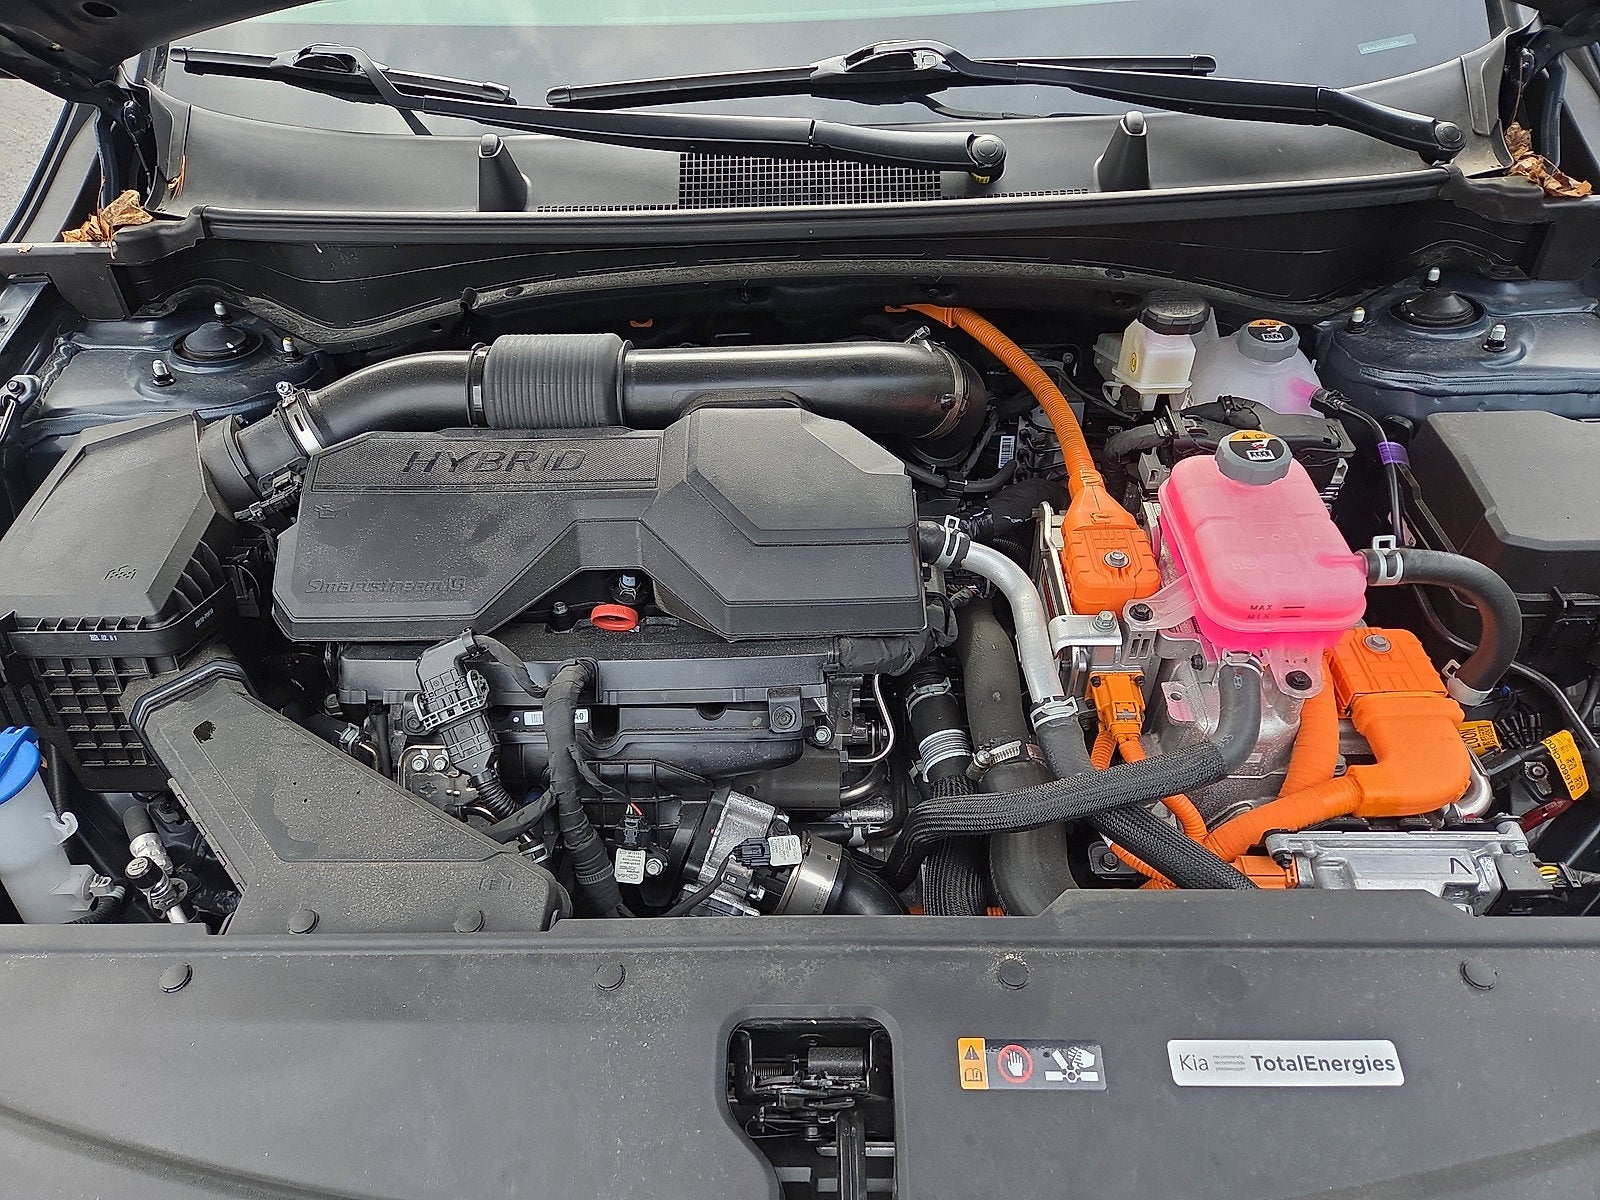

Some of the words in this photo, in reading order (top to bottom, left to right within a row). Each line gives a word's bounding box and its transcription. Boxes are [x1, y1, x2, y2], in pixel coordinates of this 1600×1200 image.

[403, 449, 587, 473] HYBRID
[1178, 1053, 1210, 1072] Kia
[1250, 1053, 1396, 1075] TotalEnergies
